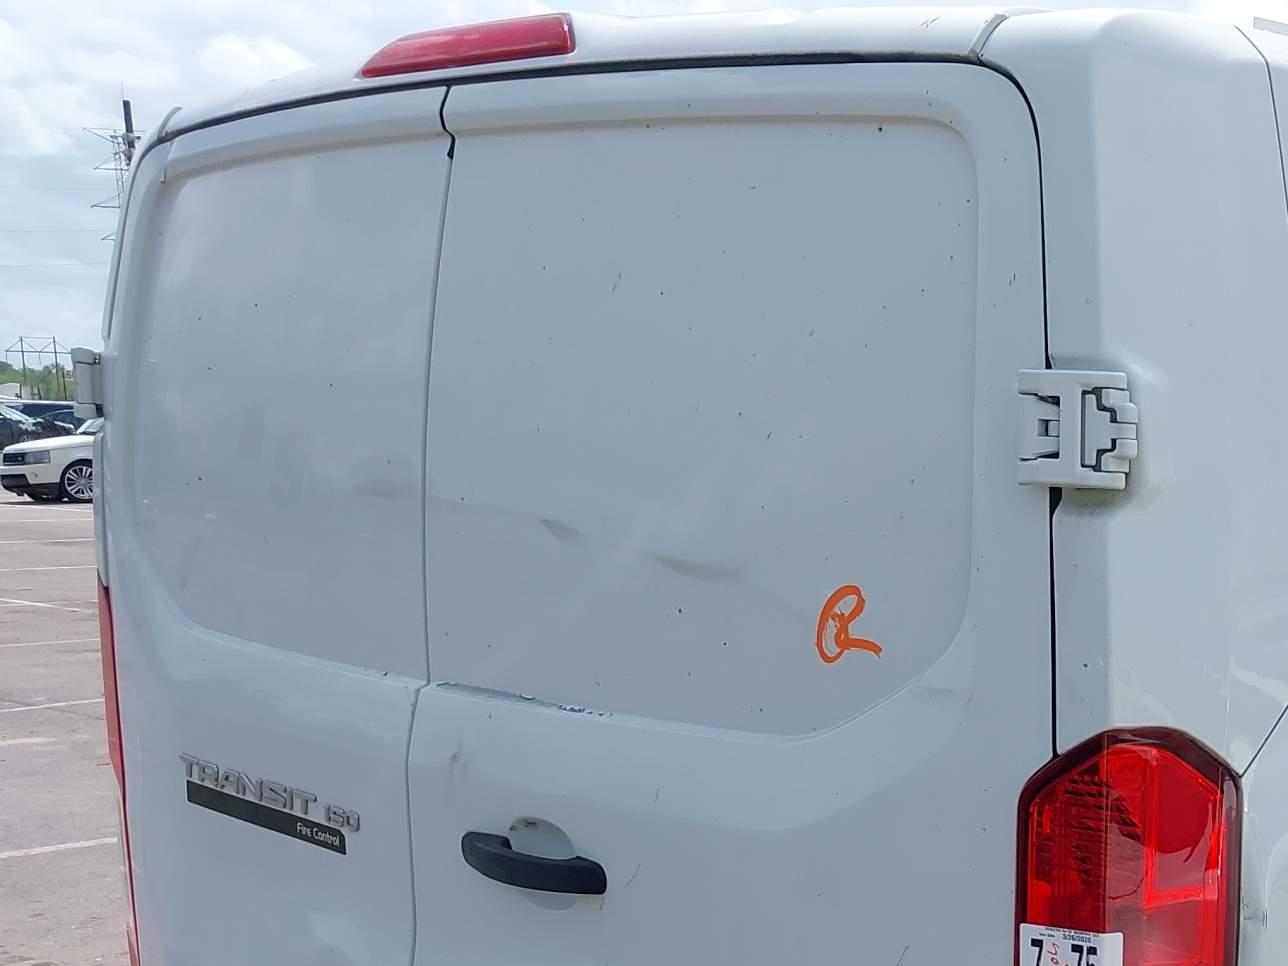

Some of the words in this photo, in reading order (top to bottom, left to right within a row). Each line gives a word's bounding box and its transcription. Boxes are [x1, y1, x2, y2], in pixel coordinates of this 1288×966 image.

[178, 752, 318, 816] TRANSIT
[296, 822, 312, 837] Fire
[313, 827, 340, 848] Control
